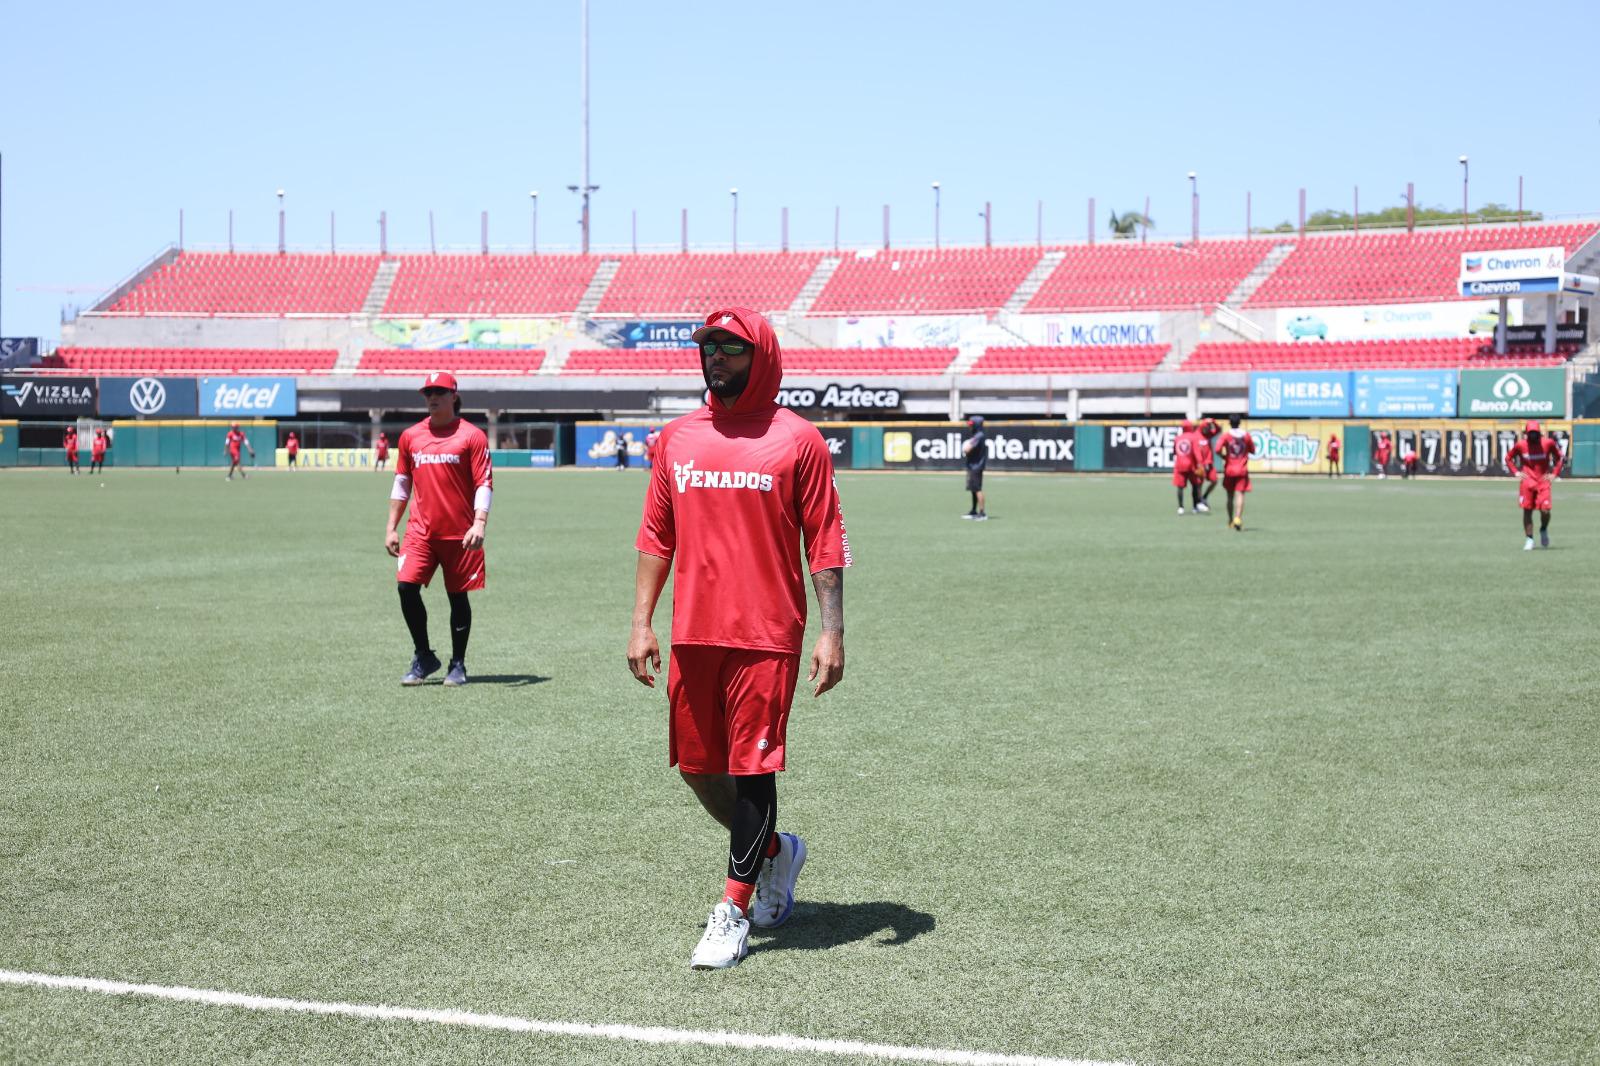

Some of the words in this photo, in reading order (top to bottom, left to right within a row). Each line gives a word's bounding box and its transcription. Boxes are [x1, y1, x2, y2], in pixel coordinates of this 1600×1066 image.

[1487, 257, 1541, 270] Chevron
[1470, 281, 1520, 296] Chevron
[1071, 323, 1155, 344] McCORMICK
[33, 386, 92, 399] VIZSLA
[213, 382, 280, 410] telcel
[821, 385, 900, 407] Azteca
[1283, 382, 1344, 398] HERSA
[1470, 398, 1509, 412] Banco
[1509, 398, 1553, 412] Azteca
[914, 431, 1075, 460] calinte.mx
[1424, 438, 1438, 465] 7
[1449, 439, 1463, 465] 9
[673, 459, 773, 494] VENADOS
